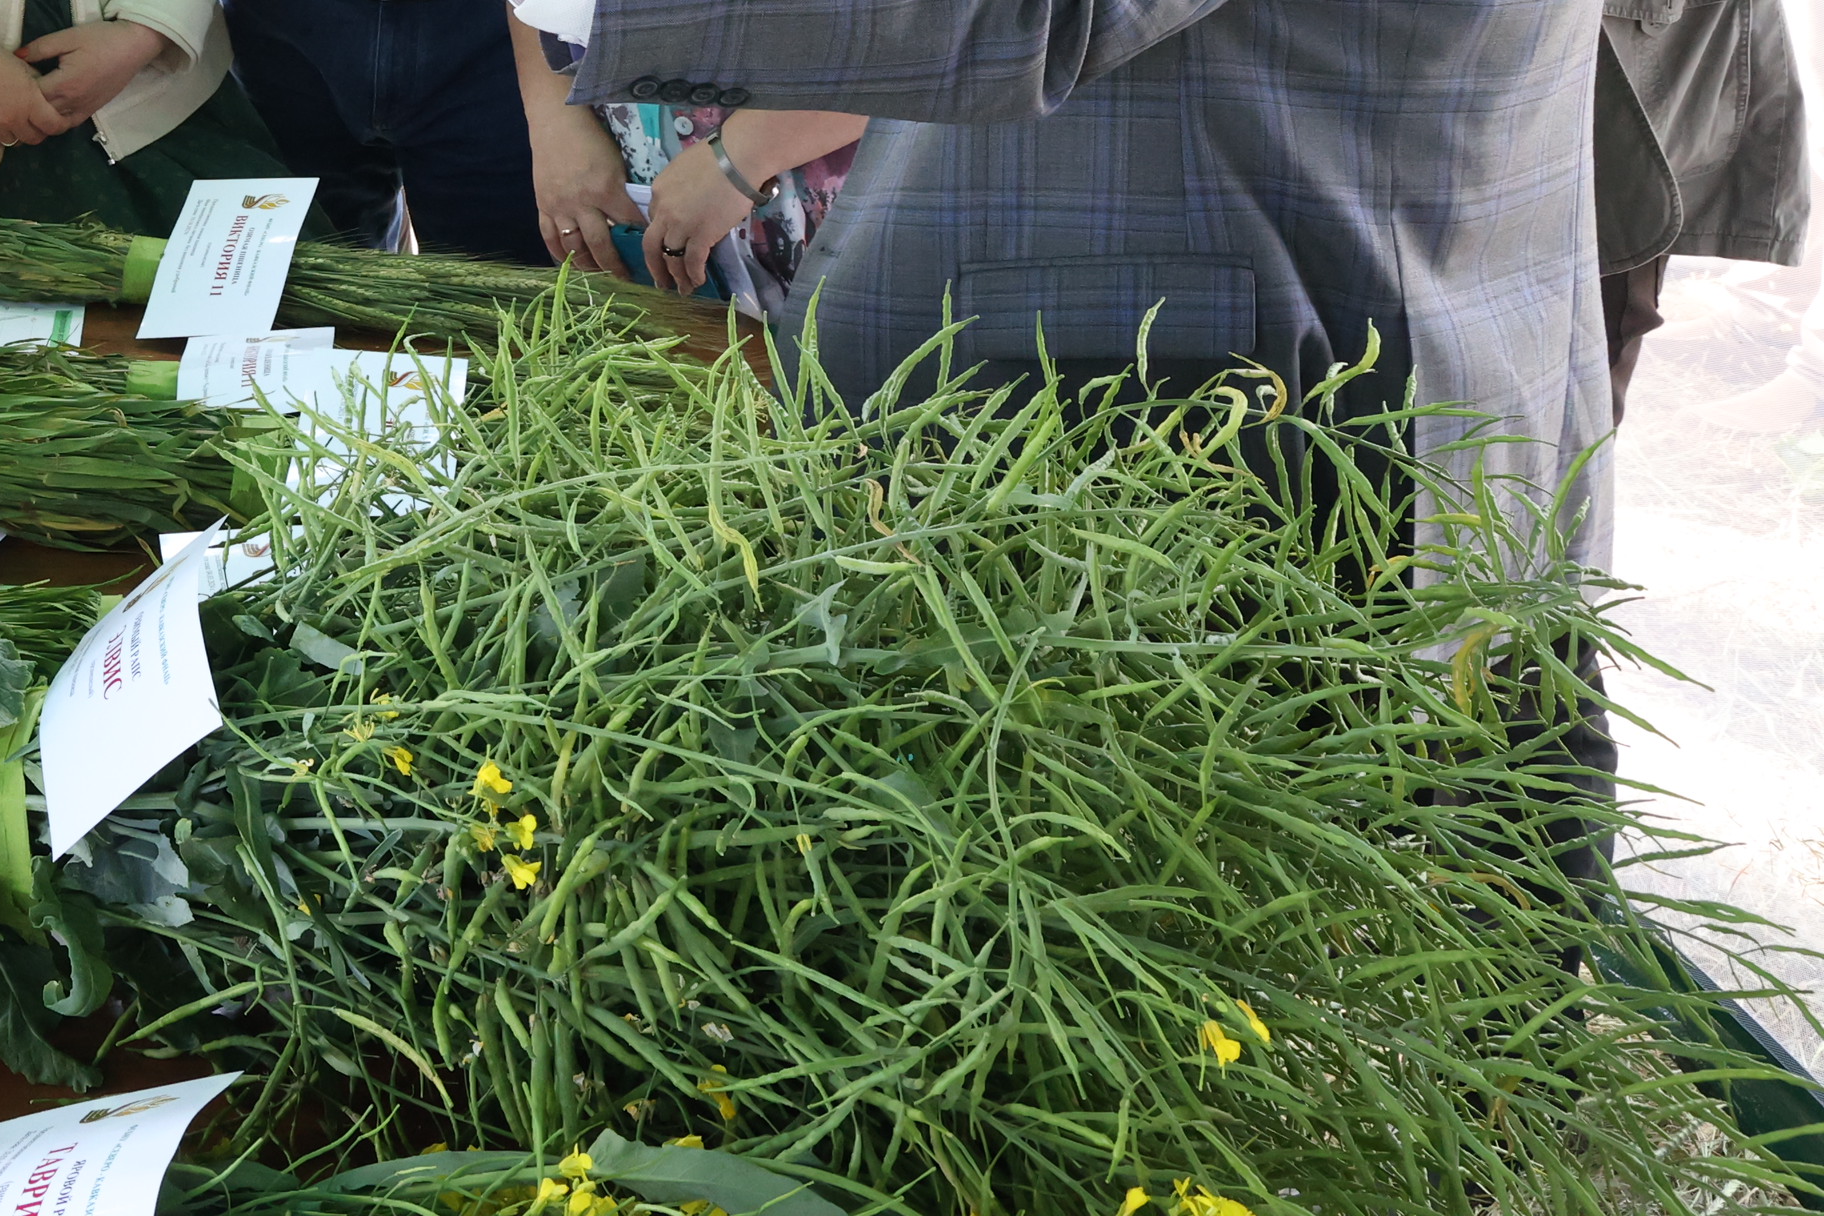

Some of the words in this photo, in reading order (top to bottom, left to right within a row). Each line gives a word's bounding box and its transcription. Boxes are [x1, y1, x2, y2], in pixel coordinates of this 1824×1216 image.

[214, 215, 249, 280] ВИКТОРИЯ
[209, 285, 224, 296] 11
[103, 624, 127, 700] ЭЛВИС
[130, 649, 142, 682] РАПС
[14, 1142, 79, 1216] ТАВРИ
[56, 1159, 87, 1206] ЯРОВОЙ
[53, 1206, 67, 1216] Р
